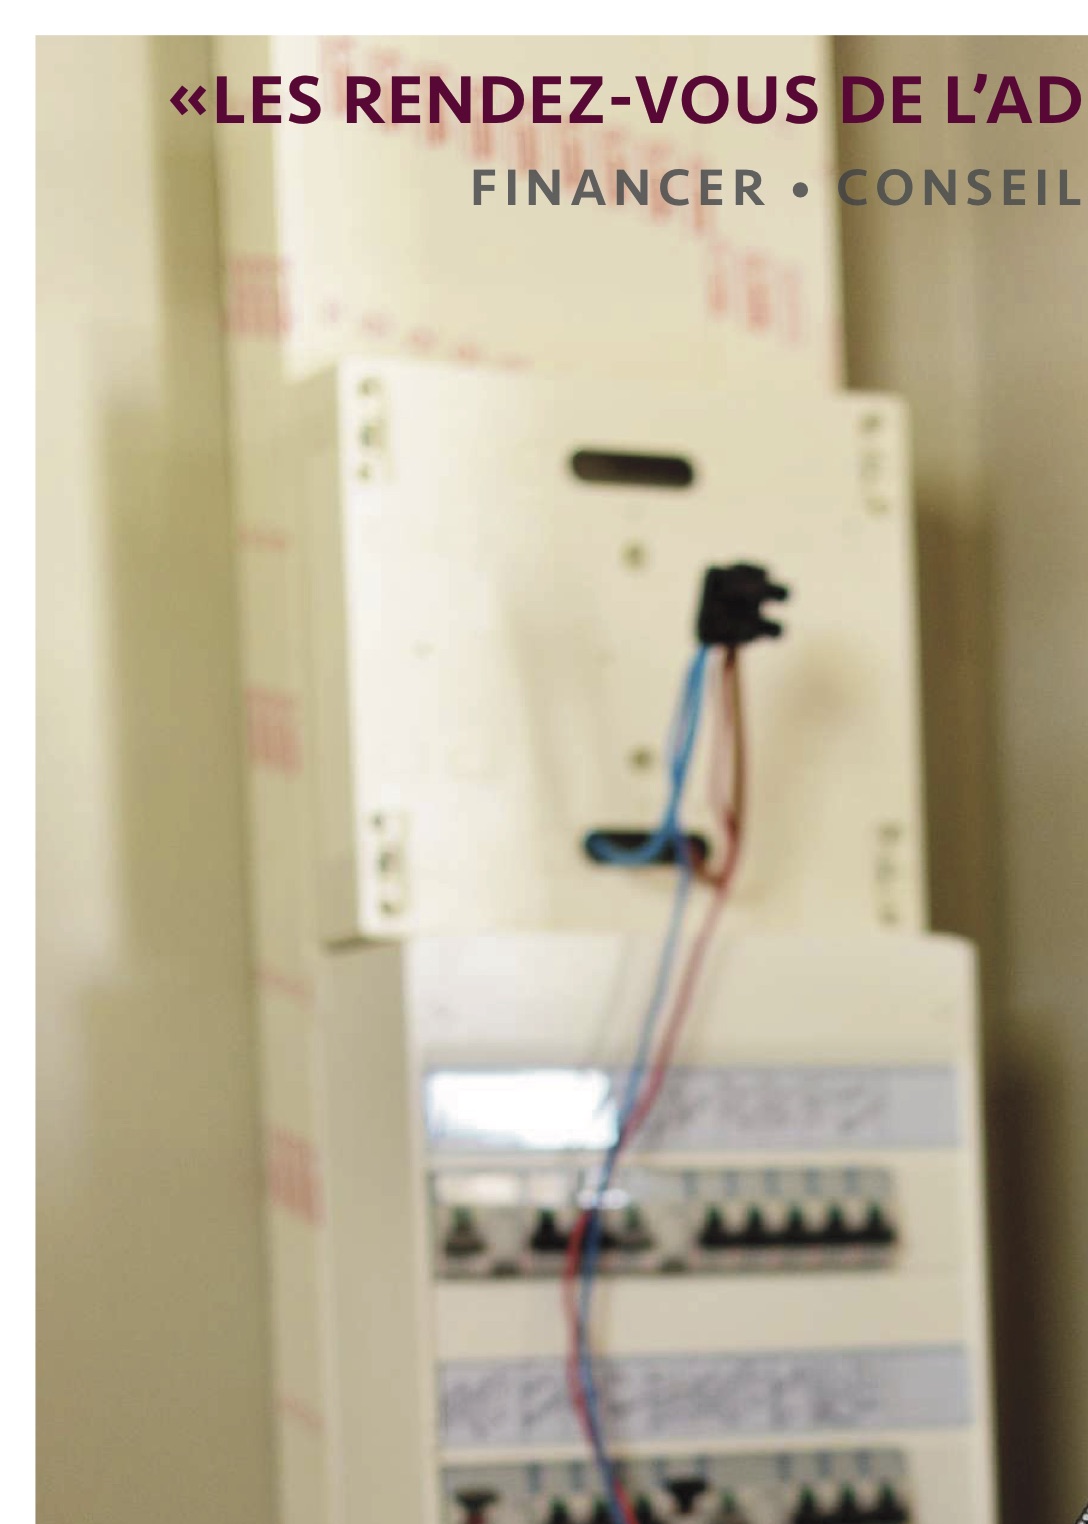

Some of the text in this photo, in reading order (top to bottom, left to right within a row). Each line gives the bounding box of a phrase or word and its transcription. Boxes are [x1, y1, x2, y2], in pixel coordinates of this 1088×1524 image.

[170, 75, 321, 125] «LES
[346, 75, 819, 125] RENDEZ-VOUS
[842, 75, 922, 125] DE
[473, 168, 766, 206] FINANCER
